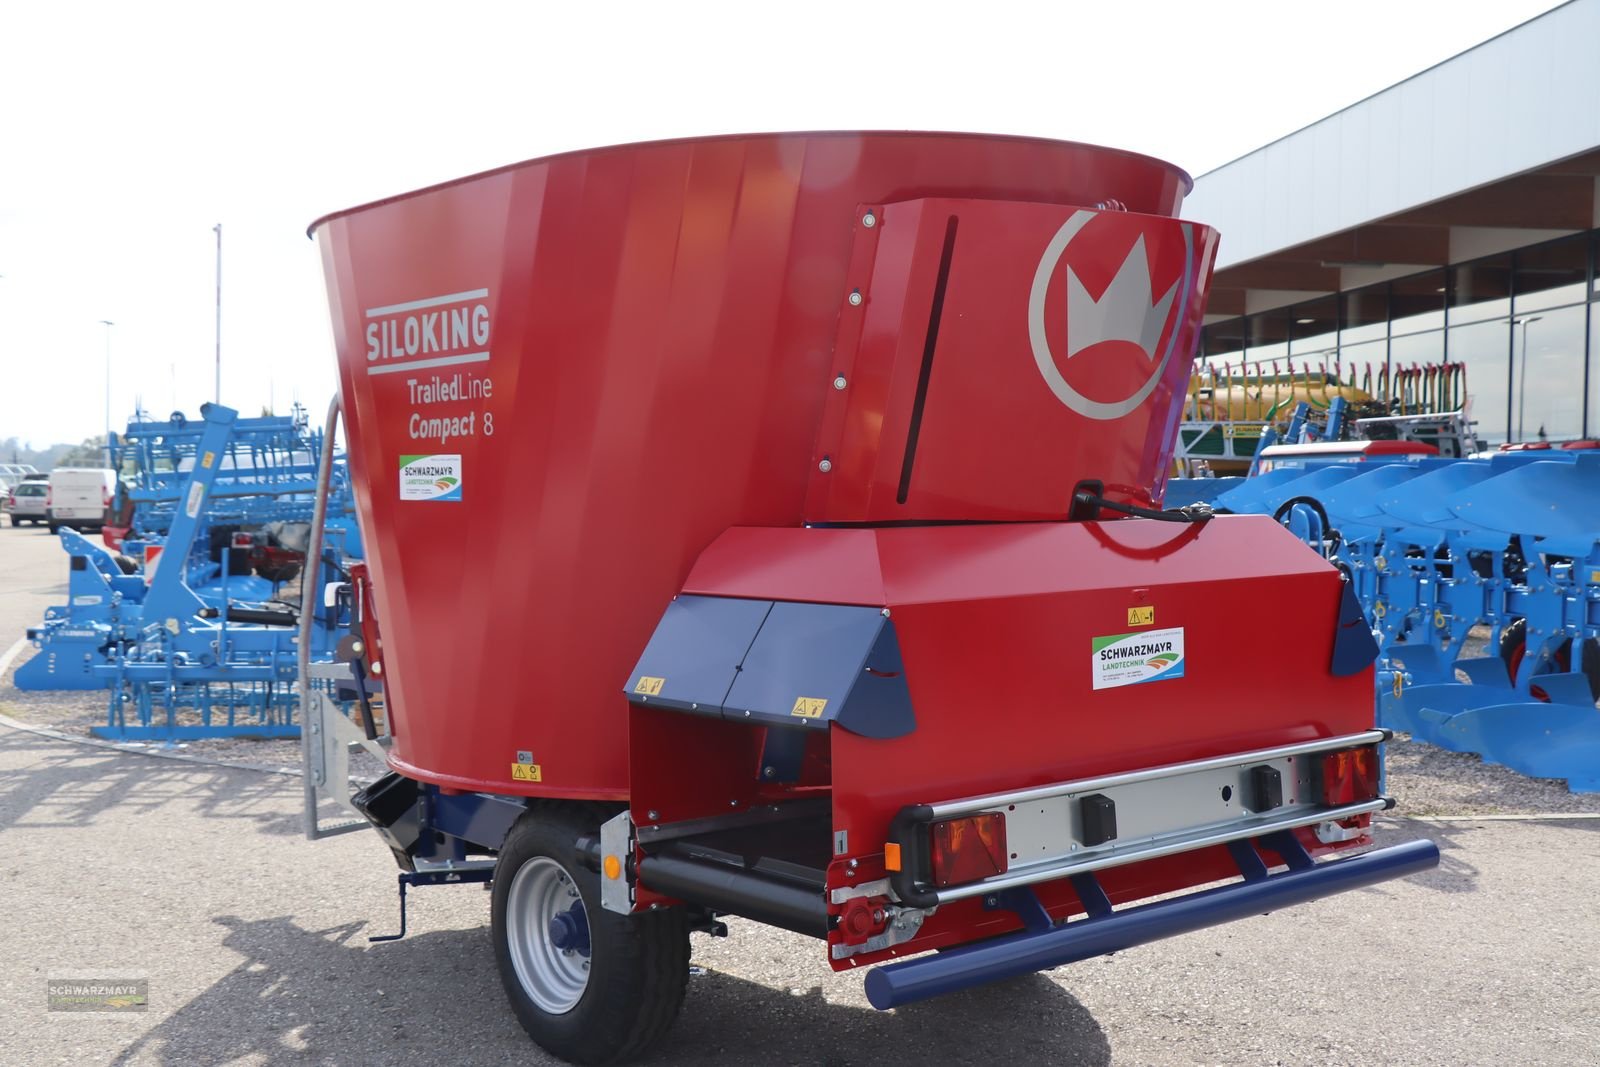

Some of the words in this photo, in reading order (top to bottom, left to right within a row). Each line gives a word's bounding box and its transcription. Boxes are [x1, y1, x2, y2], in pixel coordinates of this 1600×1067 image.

[366, 304, 490, 361] SILOKING
[407, 373, 493, 405] TrailedLine
[409, 411, 476, 445] Compact
[483, 412, 494, 436] 8
[404, 466, 453, 476] SCHWARZMAYR
[1100, 641, 1172, 661] SCHWARZMAYR
[1102, 659, 1145, 671] LANDTECHNIK
